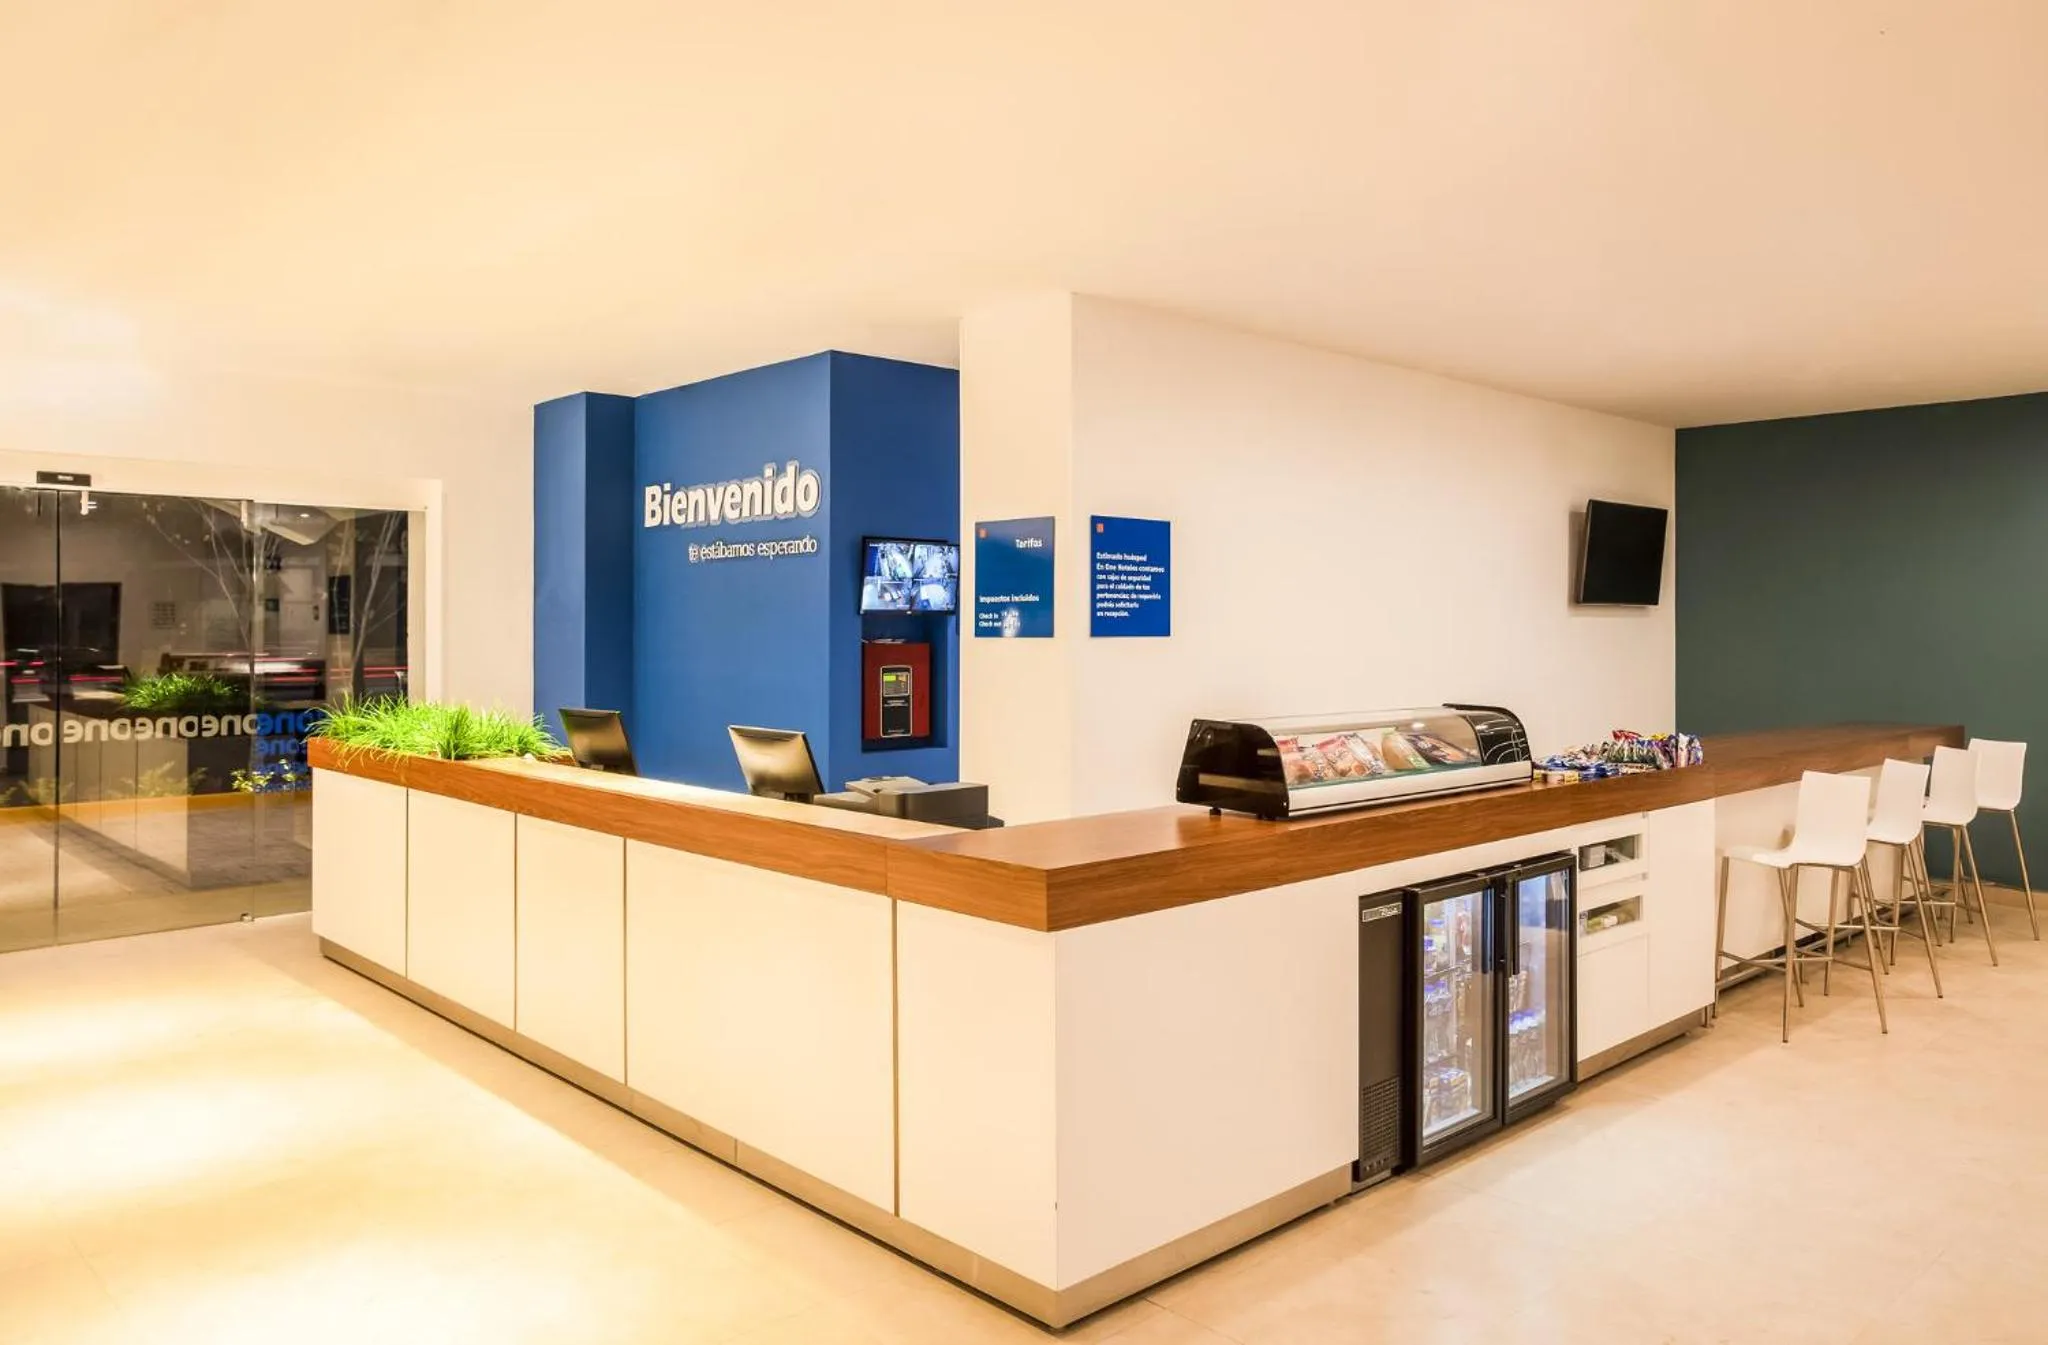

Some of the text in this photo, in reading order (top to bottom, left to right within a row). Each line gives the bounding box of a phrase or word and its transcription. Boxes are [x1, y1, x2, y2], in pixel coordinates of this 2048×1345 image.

[644, 459, 820, 528] Bienvenido
[757, 535, 817, 560] esperando
[1016, 538, 1043, 548] Tarifas
[1096, 552, 1123, 560] Estimado
[979, 594, 1040, 603] Impuestos incluidos
[979, 620, 993, 628] Check
